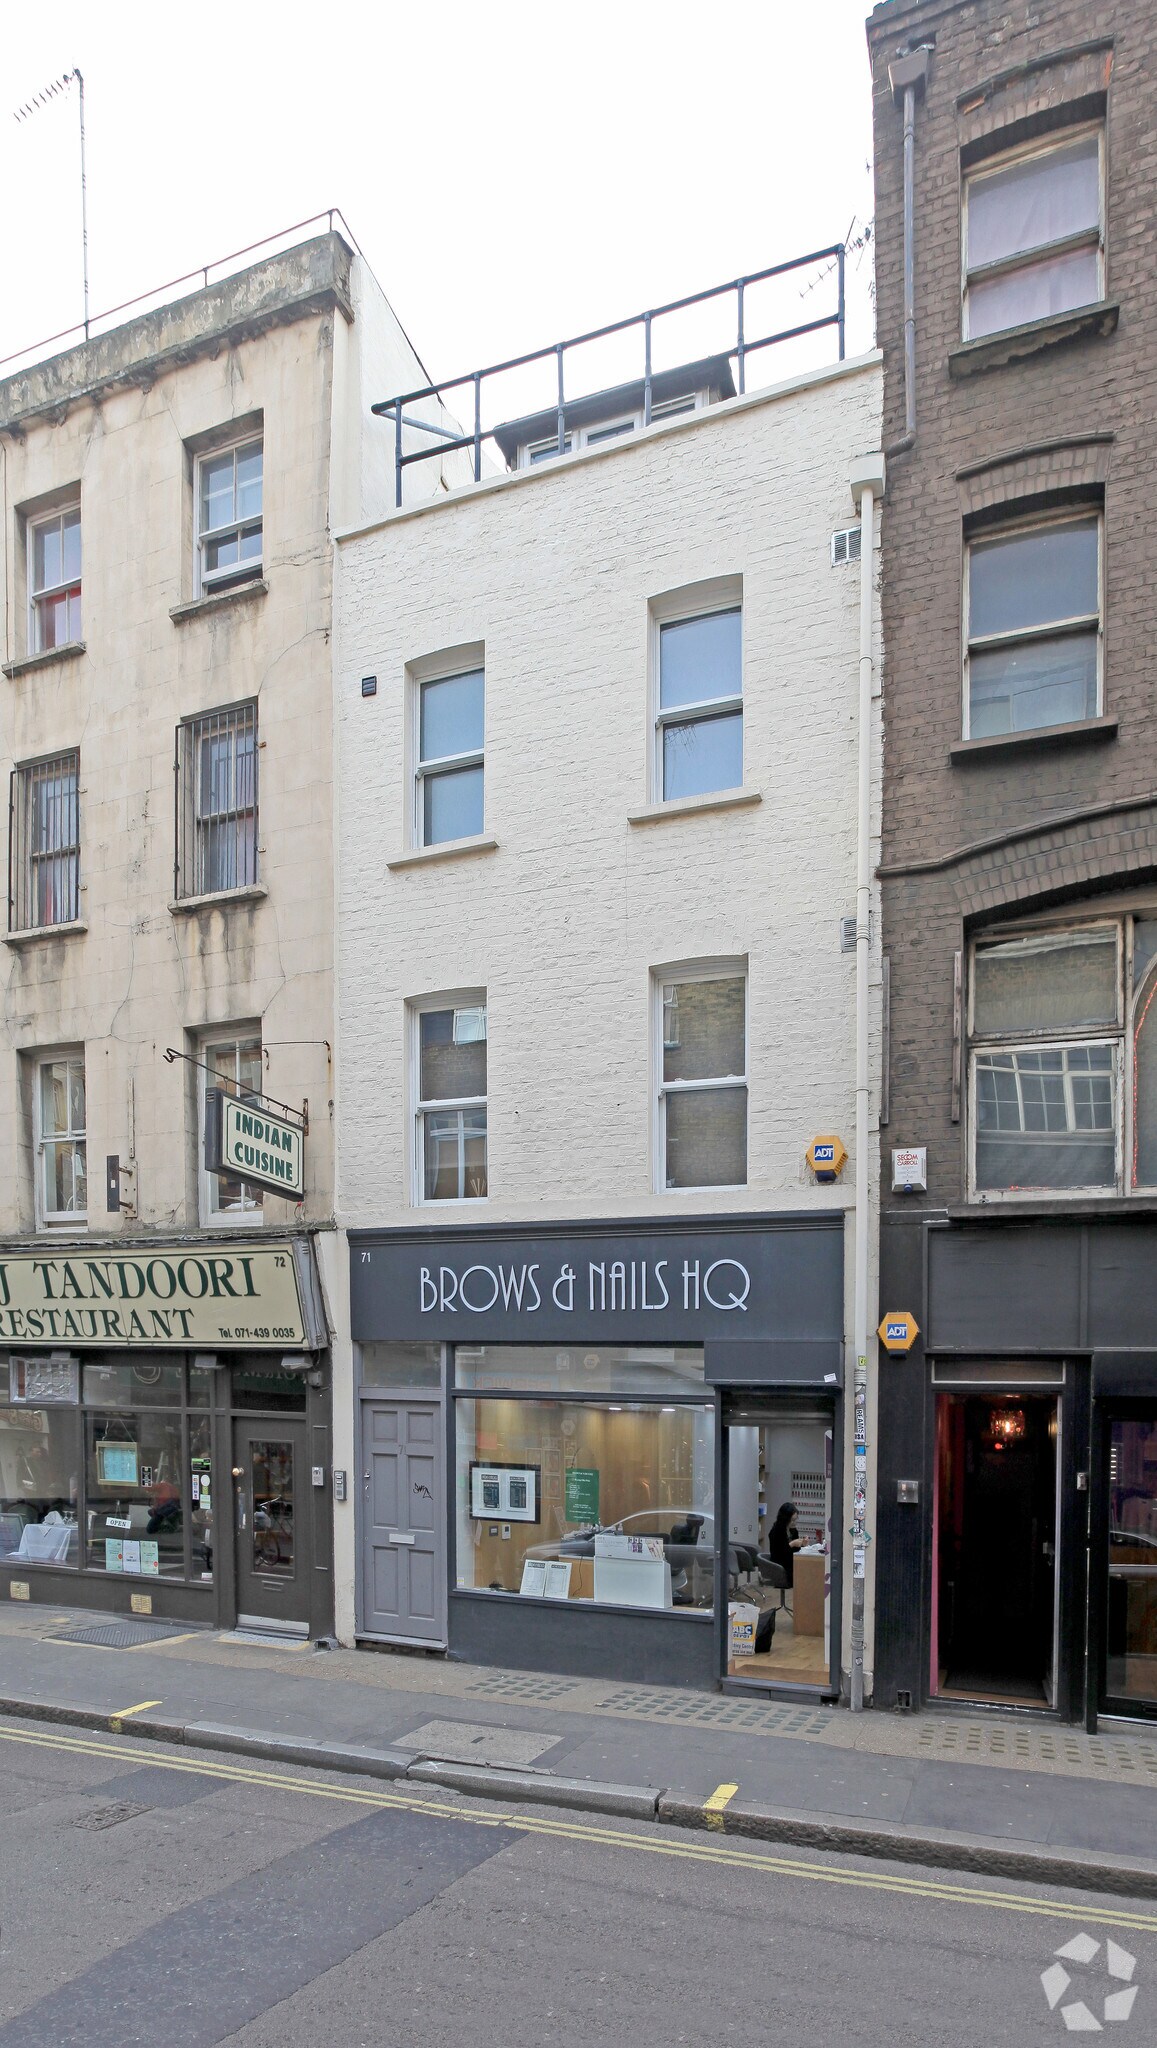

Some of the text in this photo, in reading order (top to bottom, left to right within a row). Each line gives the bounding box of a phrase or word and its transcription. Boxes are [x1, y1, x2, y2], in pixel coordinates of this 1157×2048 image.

[236, 1111, 292, 1153] INDIAN
[814, 1147, 834, 1158] ADT
[234, 1141, 293, 1182] CUISINE
[273, 1256, 286, 1268] 72
[361, 1252, 371, 1263] 71
[33, 1257, 261, 1299] TANDOORI
[420, 1258, 751, 1312] BROWS & NAILS HQ
[234, 1327, 270, 1338] 071-439
[272, 1327, 295, 1338] 0035
[887, 1326, 907, 1337] ADT
[109, 1519, 127, 1527] OPEN
[733, 1626, 751, 1634] ABC
